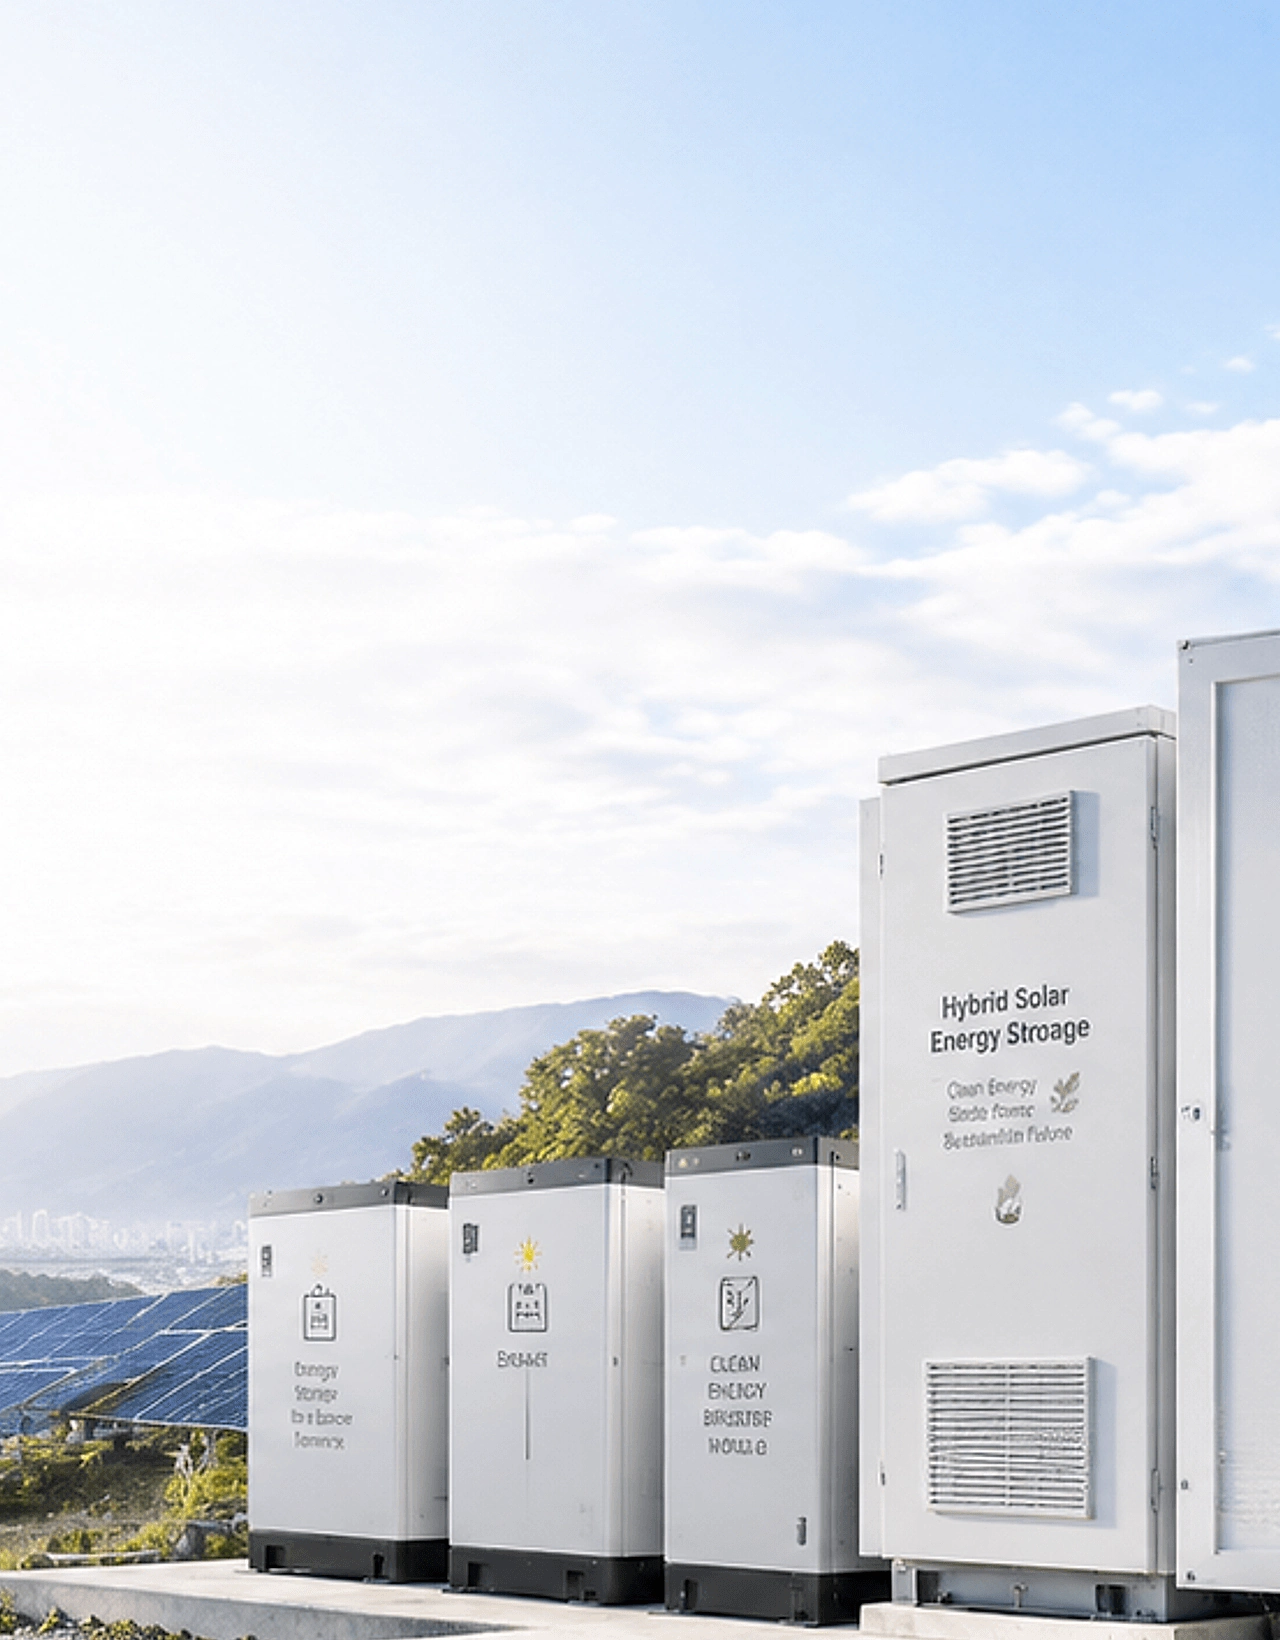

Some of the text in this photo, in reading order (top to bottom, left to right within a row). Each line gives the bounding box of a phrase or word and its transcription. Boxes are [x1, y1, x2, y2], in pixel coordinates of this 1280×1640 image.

[942, 984, 1069, 1022] Hybrid Solar
[931, 1019, 1090, 1053] Energy Stroage
